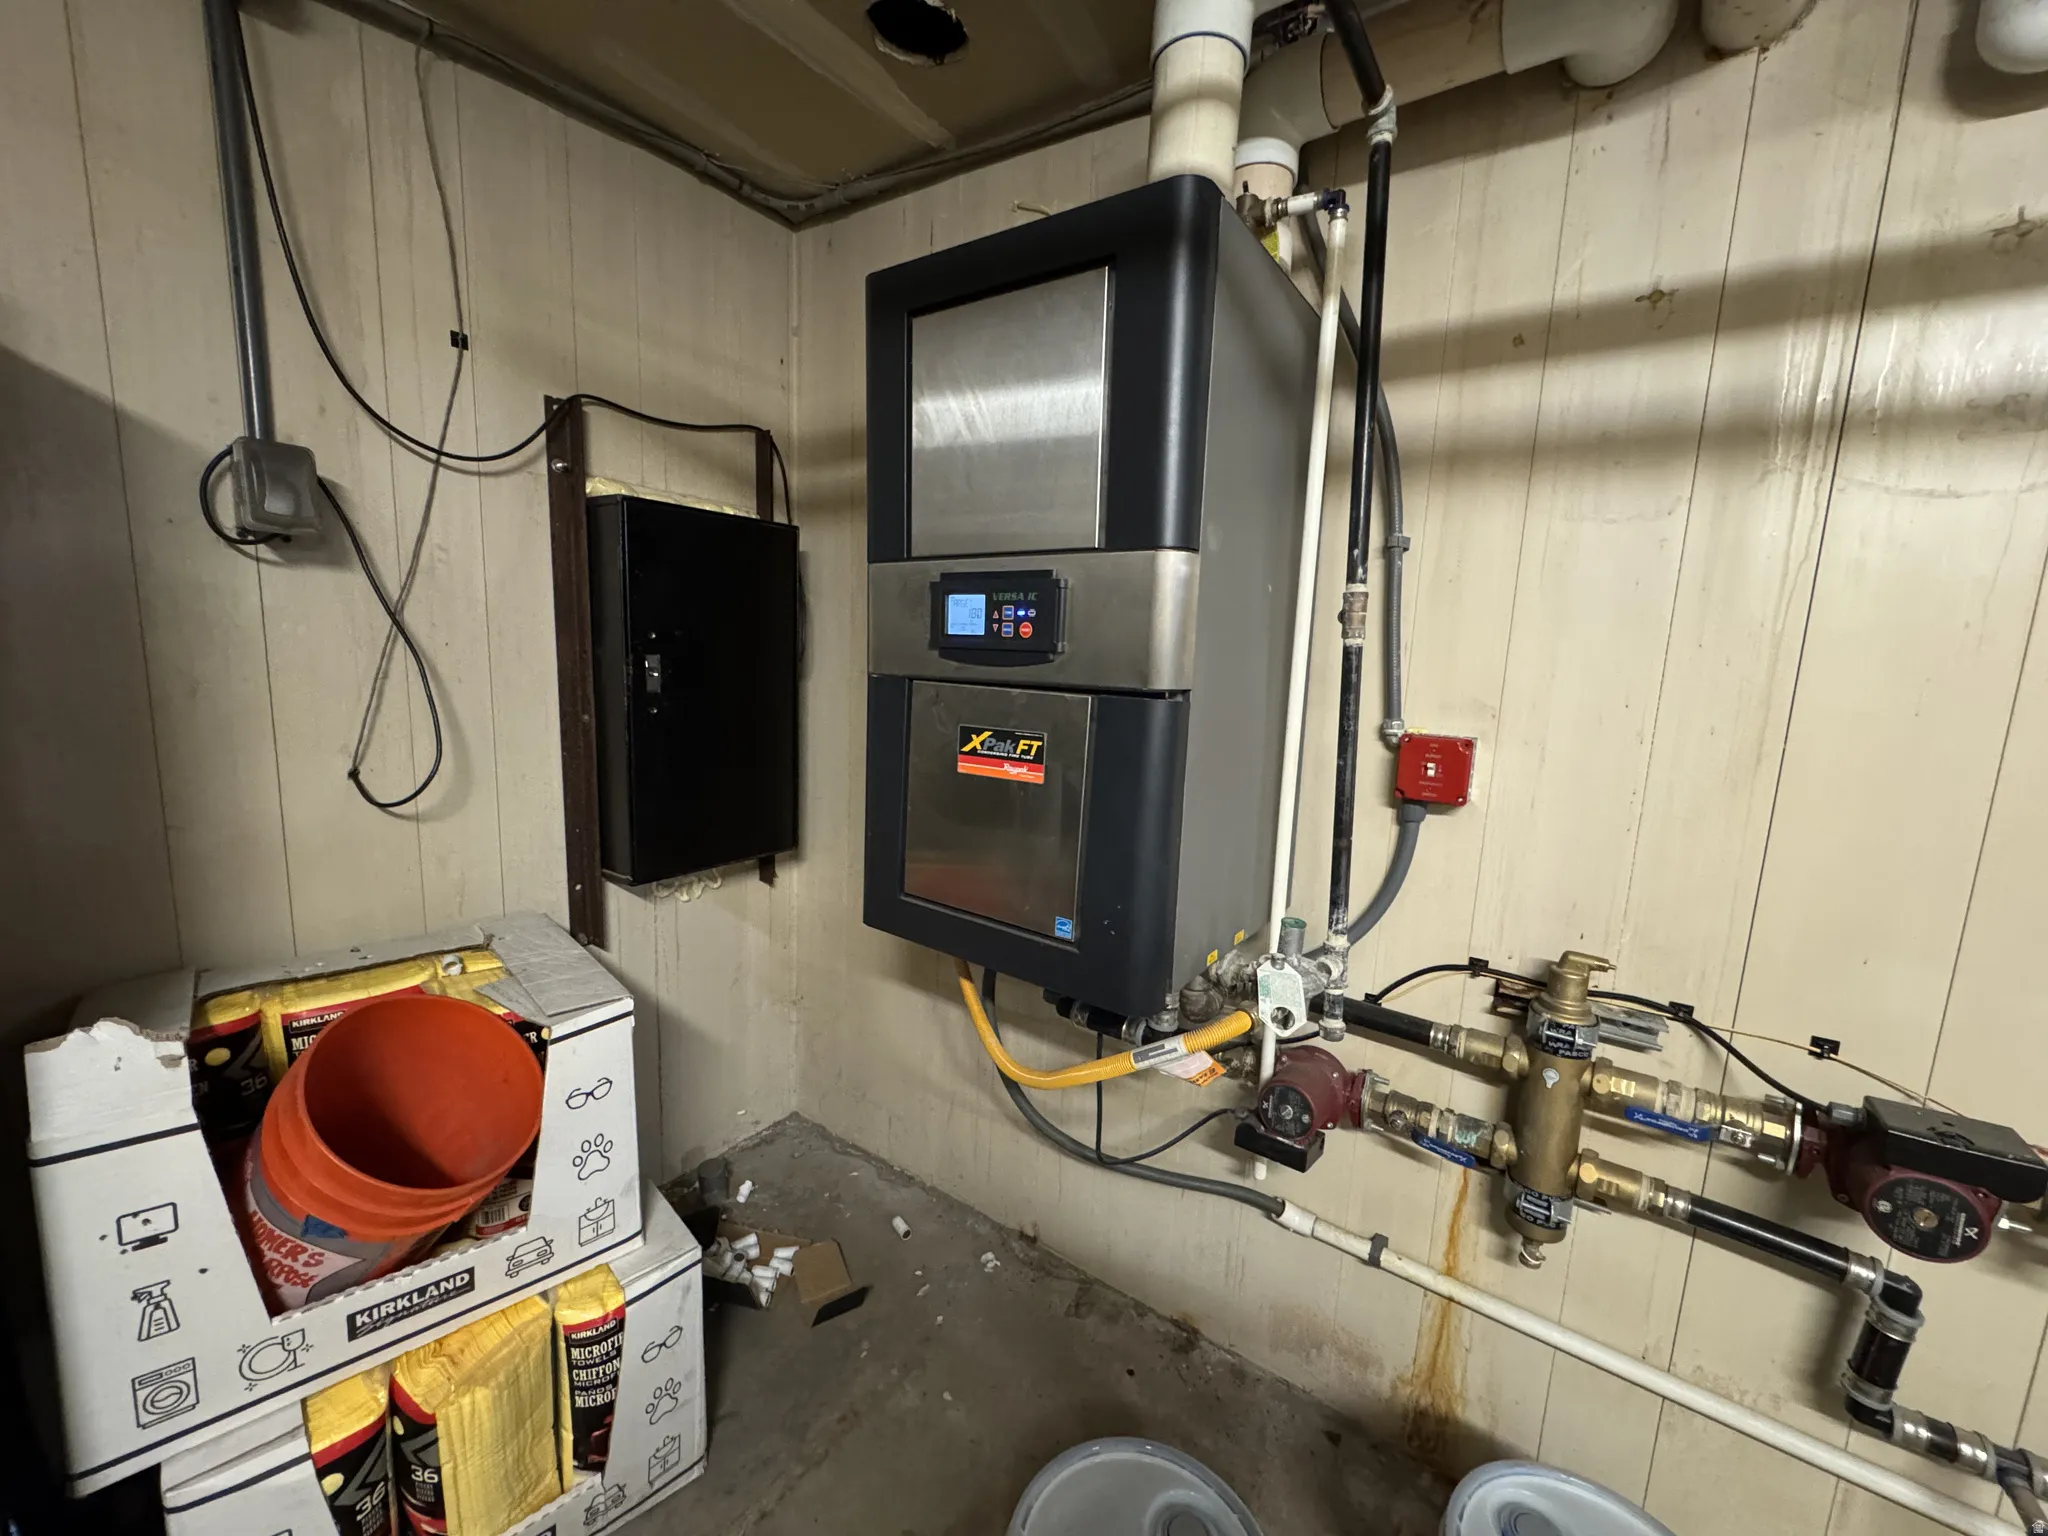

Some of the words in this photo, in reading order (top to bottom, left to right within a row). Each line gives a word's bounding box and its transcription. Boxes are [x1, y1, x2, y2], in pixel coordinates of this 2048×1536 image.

[993, 592, 1024, 601] VERSA
[1027, 592, 1039, 601] IC
[355, 1272, 470, 1328] KIRKLAND
[571, 1319, 616, 1340] KIRKLAND
[572, 1349, 617, 1366] TOWELS
[574, 1383, 613, 1396] PAÑOS
[411, 1464, 438, 1483] 36
[355, 1481, 386, 1522] 36
